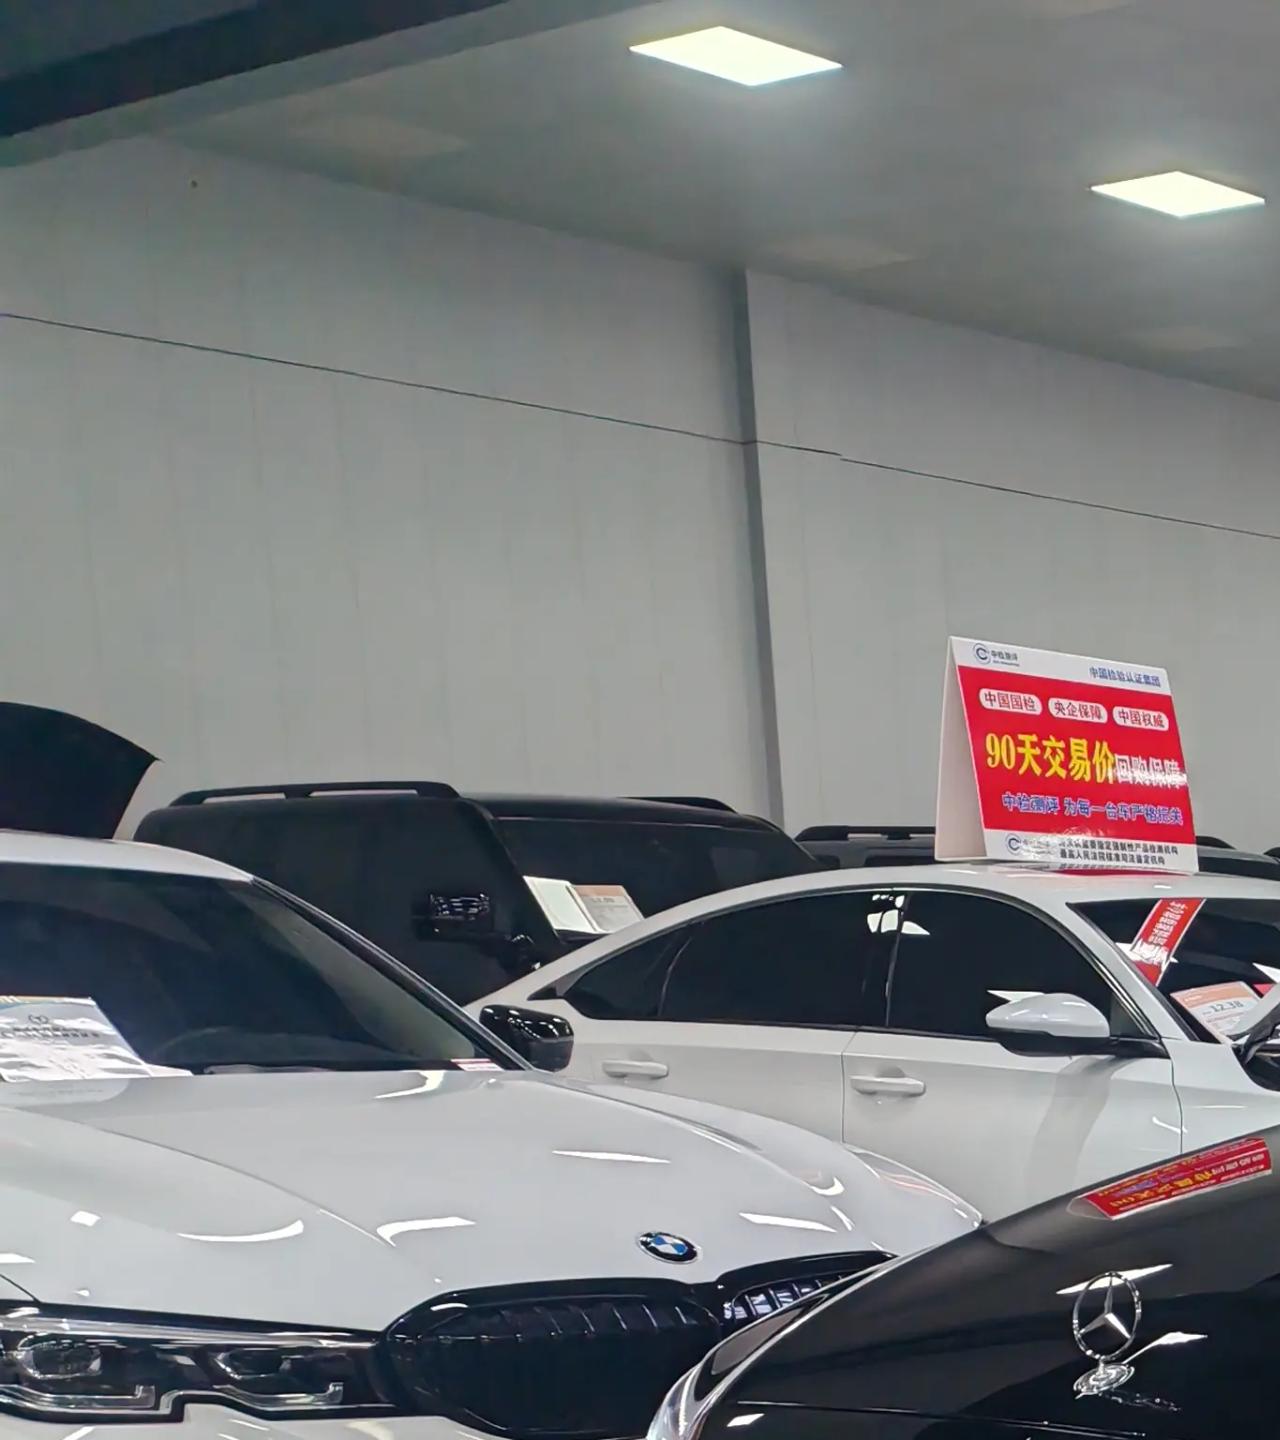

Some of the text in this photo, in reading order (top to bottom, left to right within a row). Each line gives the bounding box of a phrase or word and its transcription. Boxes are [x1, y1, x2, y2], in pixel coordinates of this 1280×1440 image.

[984, 691, 1166, 729] 中国国检 央企保障 中国权威
